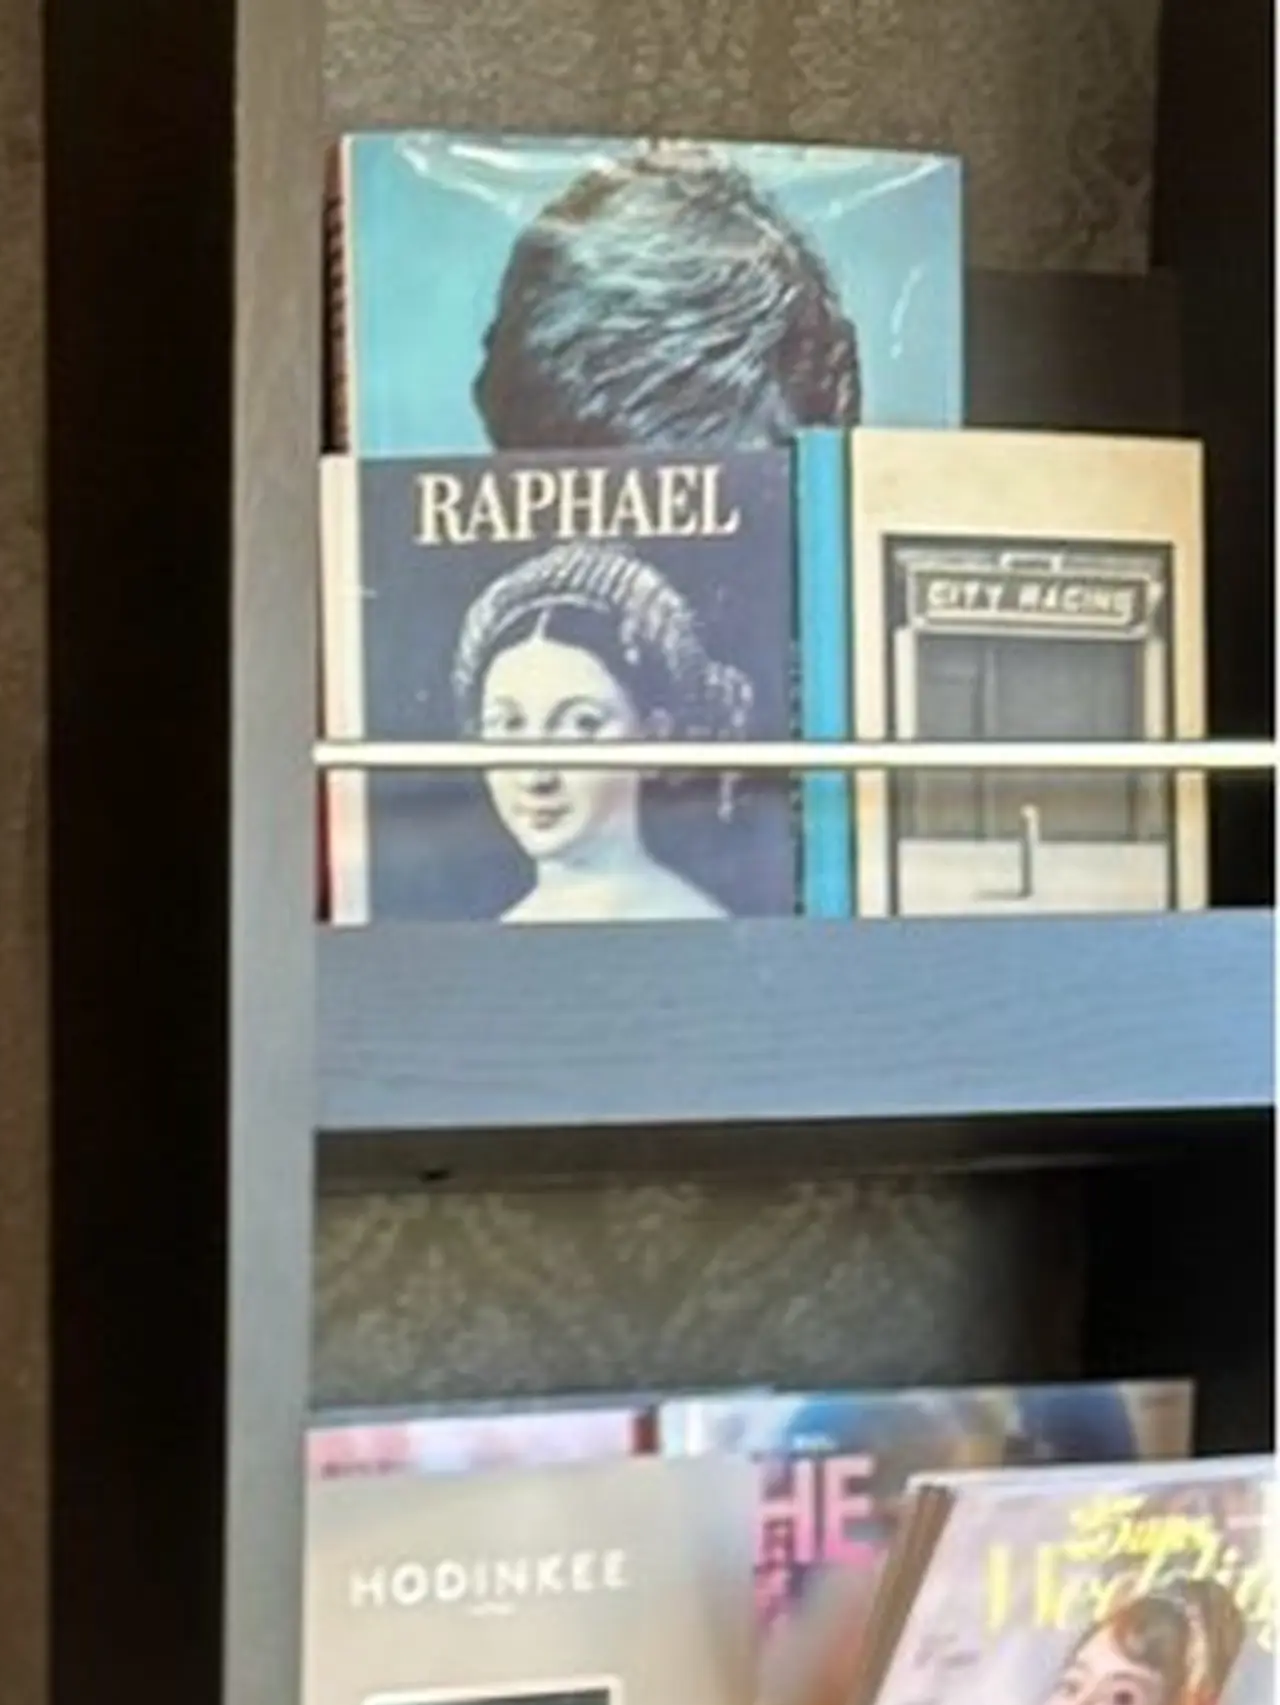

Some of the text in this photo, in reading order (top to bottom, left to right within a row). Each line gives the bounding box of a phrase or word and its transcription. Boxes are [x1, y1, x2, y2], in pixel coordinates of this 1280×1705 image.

[413, 463, 740, 546] RAPHAEL
[926, 578, 1005, 613] CITY
[348, 1548, 630, 1608] HODINKEE
